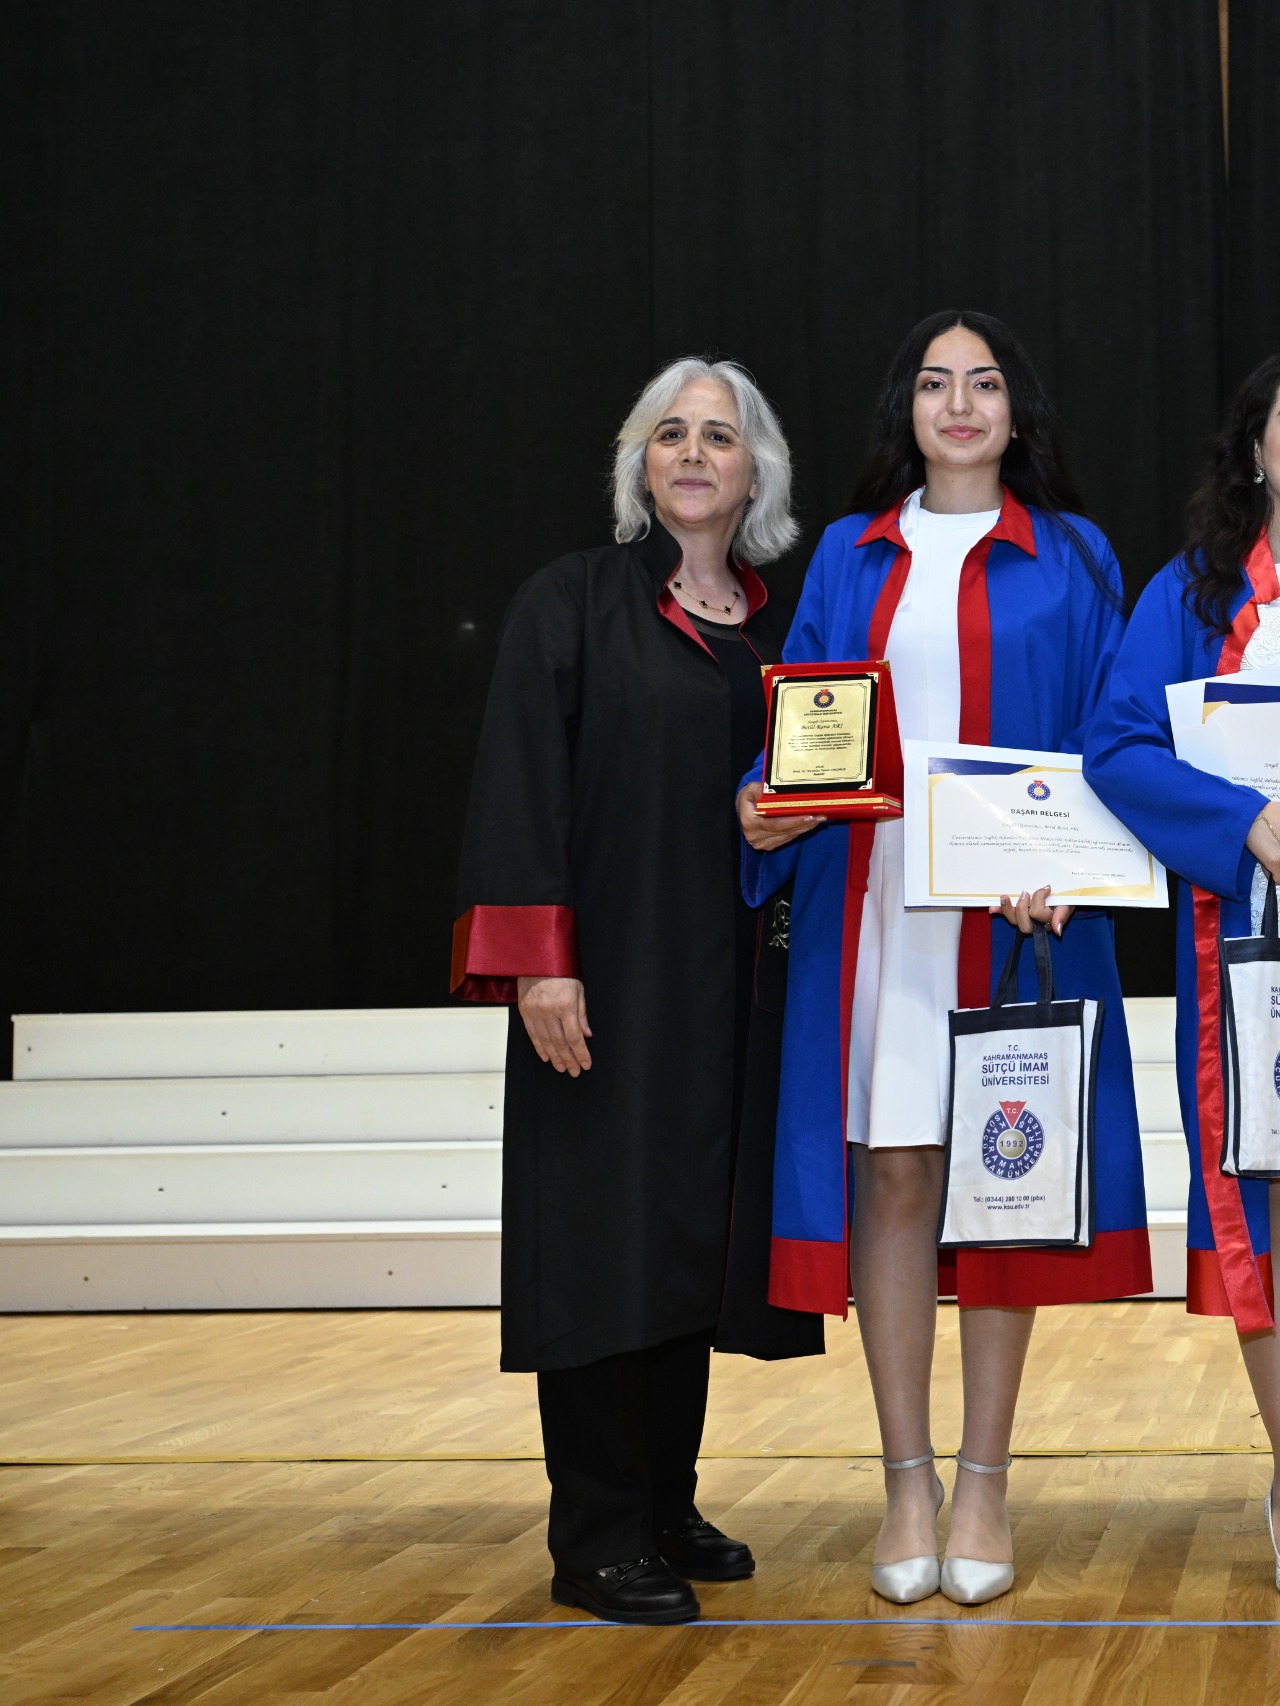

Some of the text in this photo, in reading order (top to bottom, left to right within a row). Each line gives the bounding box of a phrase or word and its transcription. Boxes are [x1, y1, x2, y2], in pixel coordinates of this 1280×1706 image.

[1010, 808, 1070, 818] BAŞARI BELGESİ
[1008, 1044, 1020, 1052] T.C.
[983, 1052, 1048, 1061] KAHRAMANMARAŞ
[982, 1060, 1049, 1074] SÜTÇÜ İMAM
[981, 1073, 1050, 1087] ÜNİVERSİTESİ
[1000, 1140, 1024, 1148] 1992
